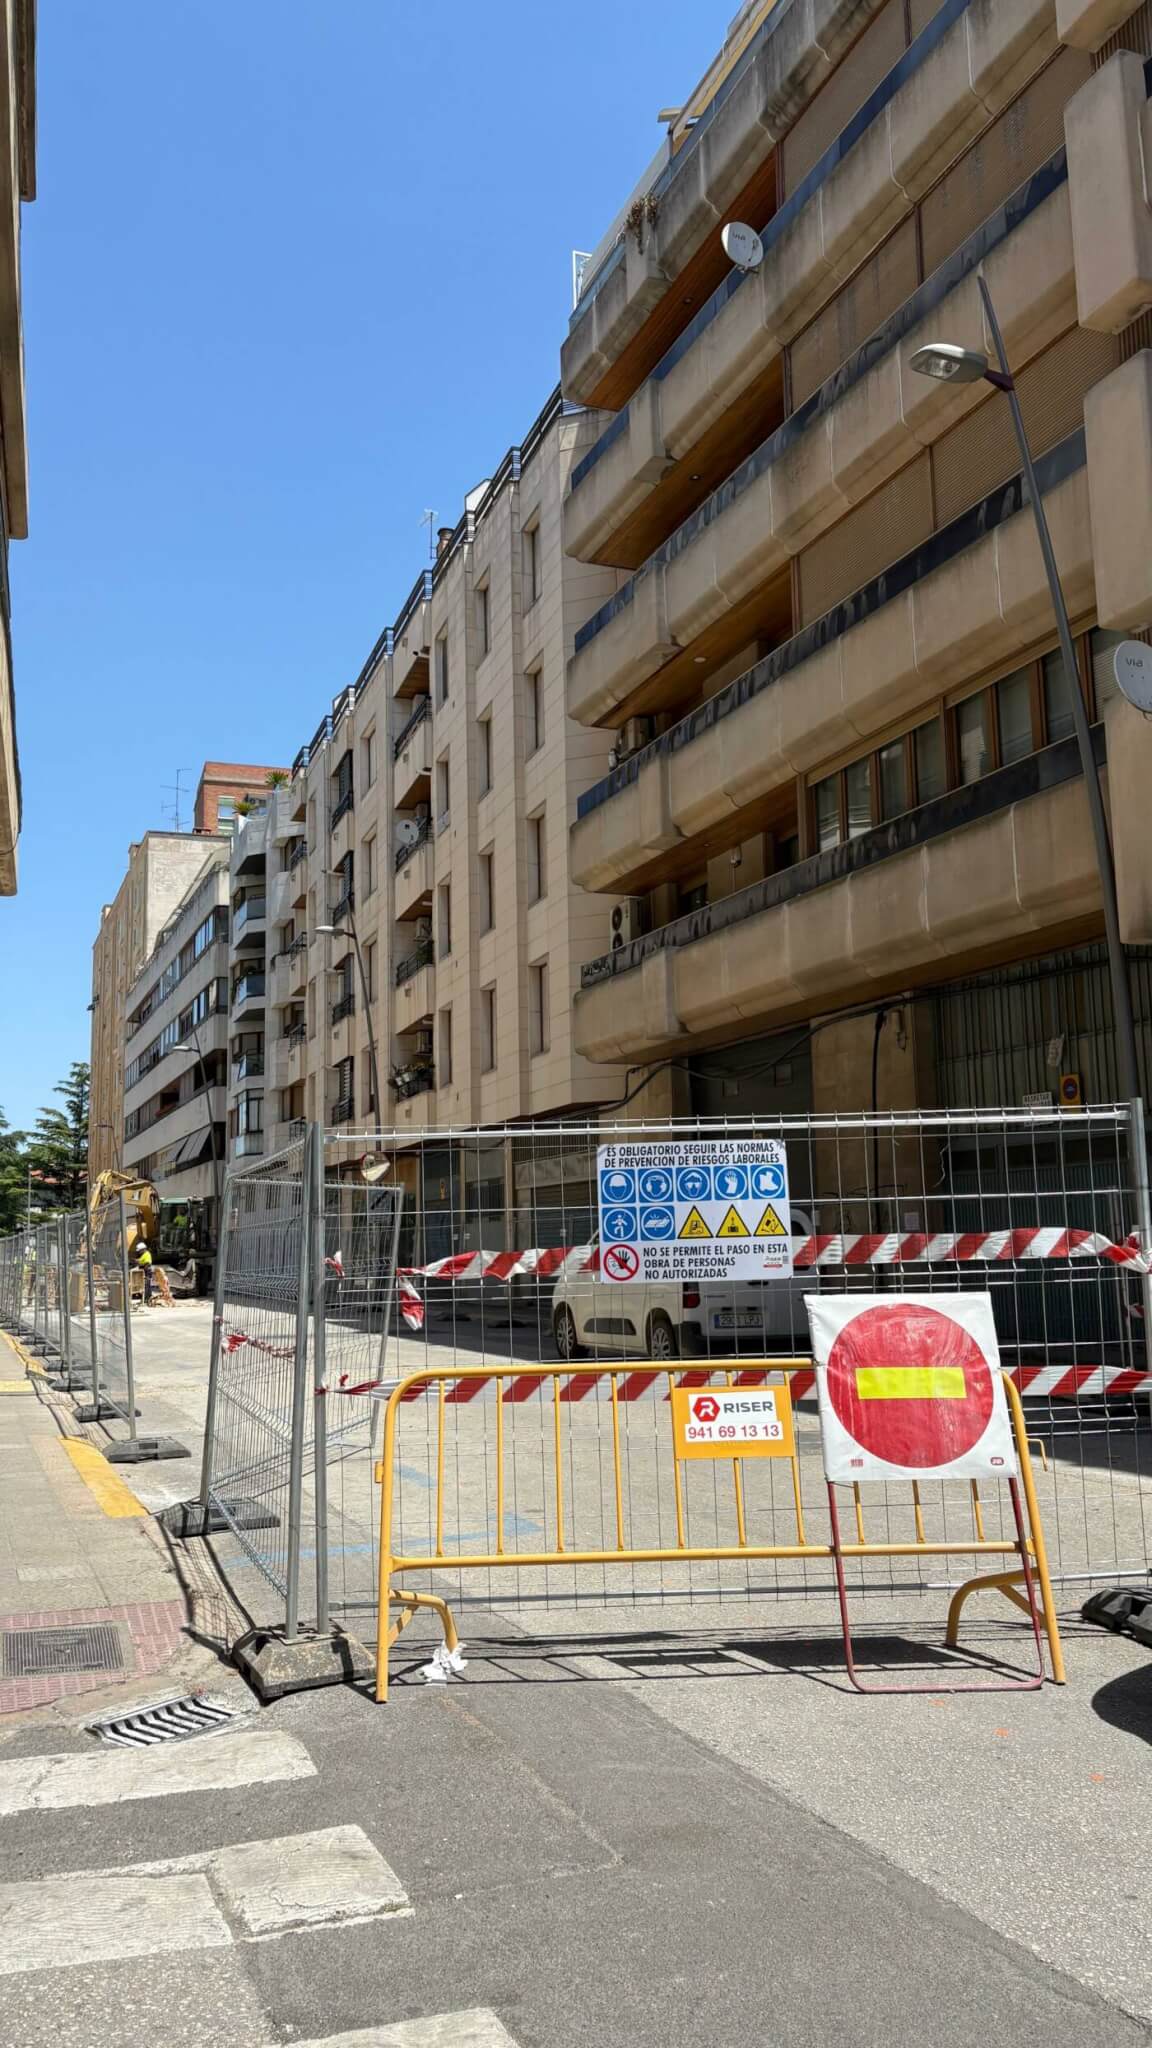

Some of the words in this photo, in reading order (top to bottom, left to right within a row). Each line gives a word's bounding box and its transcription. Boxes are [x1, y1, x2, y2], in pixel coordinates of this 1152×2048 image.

[607, 1147, 617, 1157] ES
[620, 1145, 681, 1157] OBLIGATORIO
[684, 1143, 717, 1155] SEGUIR
[720, 1143, 735, 1153] LAS
[737, 1142, 774, 1153] NORMAS
[604, 1158, 616, 1168] DE
[619, 1156, 675, 1168] PREVENCION
[678, 1155, 690, 1166] DE
[692, 1154, 730, 1165] RIESGOS
[732, 1153, 780, 1164] LABORALES
[643, 1247, 657, 1257] NO
[660, 1246, 670, 1257] SE
[673, 1245, 712, 1256] PERMITE
[714, 1245, 724, 1255] EL
[727, 1244, 750, 1254] PASO
[753, 1244, 765, 1254] EN
[767, 1243, 788, 1253] ESTA
[644, 1258, 670, 1269] OBRA
[672, 1258, 685, 1268] DE
[688, 1256, 736, 1267] PERSONAS
[645, 1269, 660, 1279] NO
[662, 1267, 728, 1279] AUTORIZADAS
[723, 1401, 774, 1414] RISER
[688, 1426, 713, 1439] 941
[718, 1425, 736, 1438] 69
[740, 1425, 758, 1437] 13
[762, 1424, 780, 1437] 13
